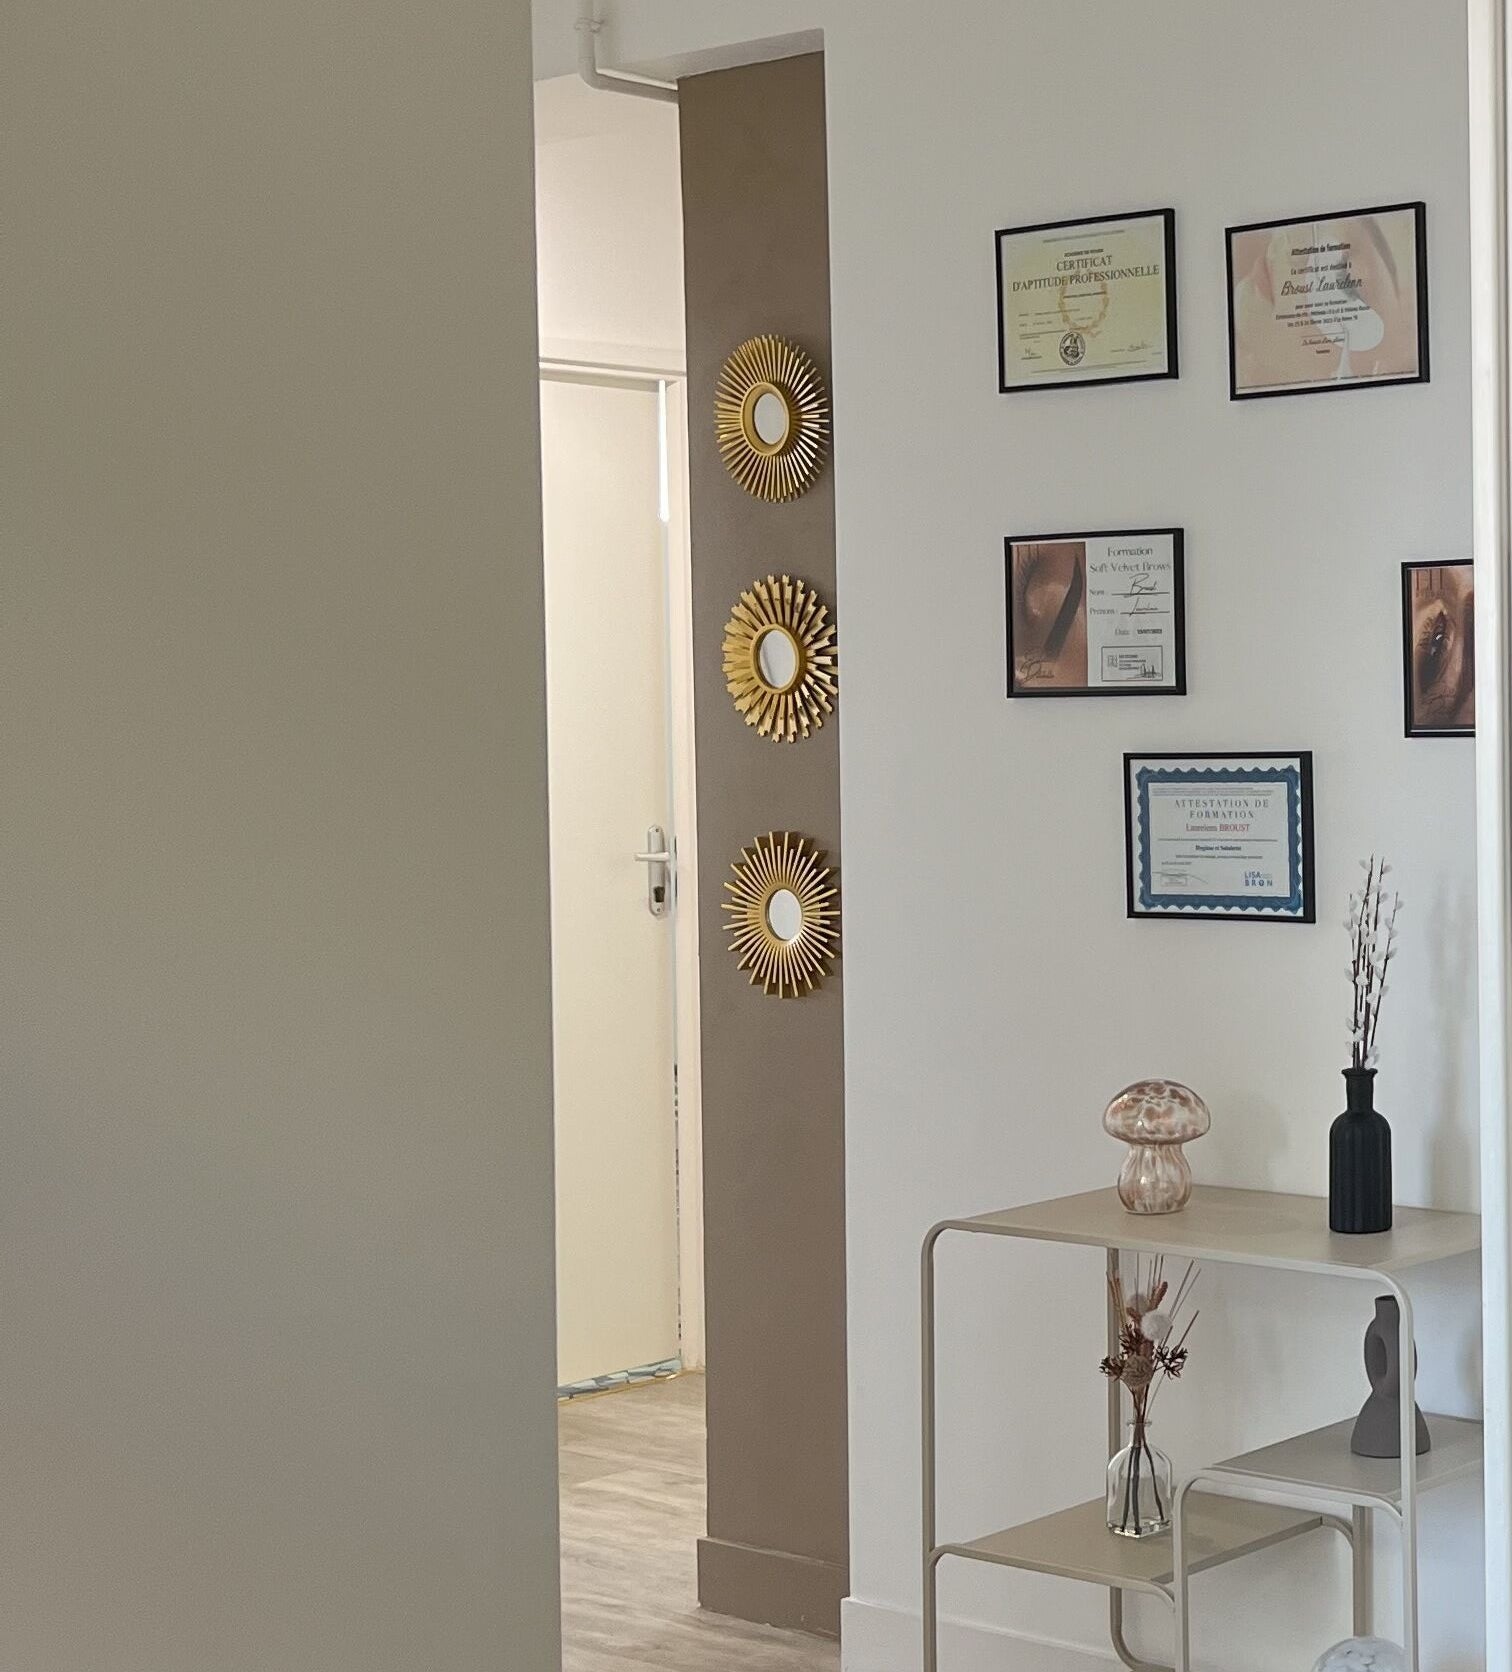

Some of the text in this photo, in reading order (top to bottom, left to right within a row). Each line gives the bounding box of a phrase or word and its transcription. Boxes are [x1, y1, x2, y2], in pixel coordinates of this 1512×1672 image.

[1056, 255, 1112, 272] CERTIFICAT
[1070, 264, 1160, 286] PROFESSIONNELLE
[1107, 547, 1153, 557] Formation
[1111, 562, 1139, 572] Velvet
[1175, 799, 1269, 808] ATTESTATION DE
[1189, 810, 1254, 819] FORMATION
[1219, 823, 1250, 832] BROUST
